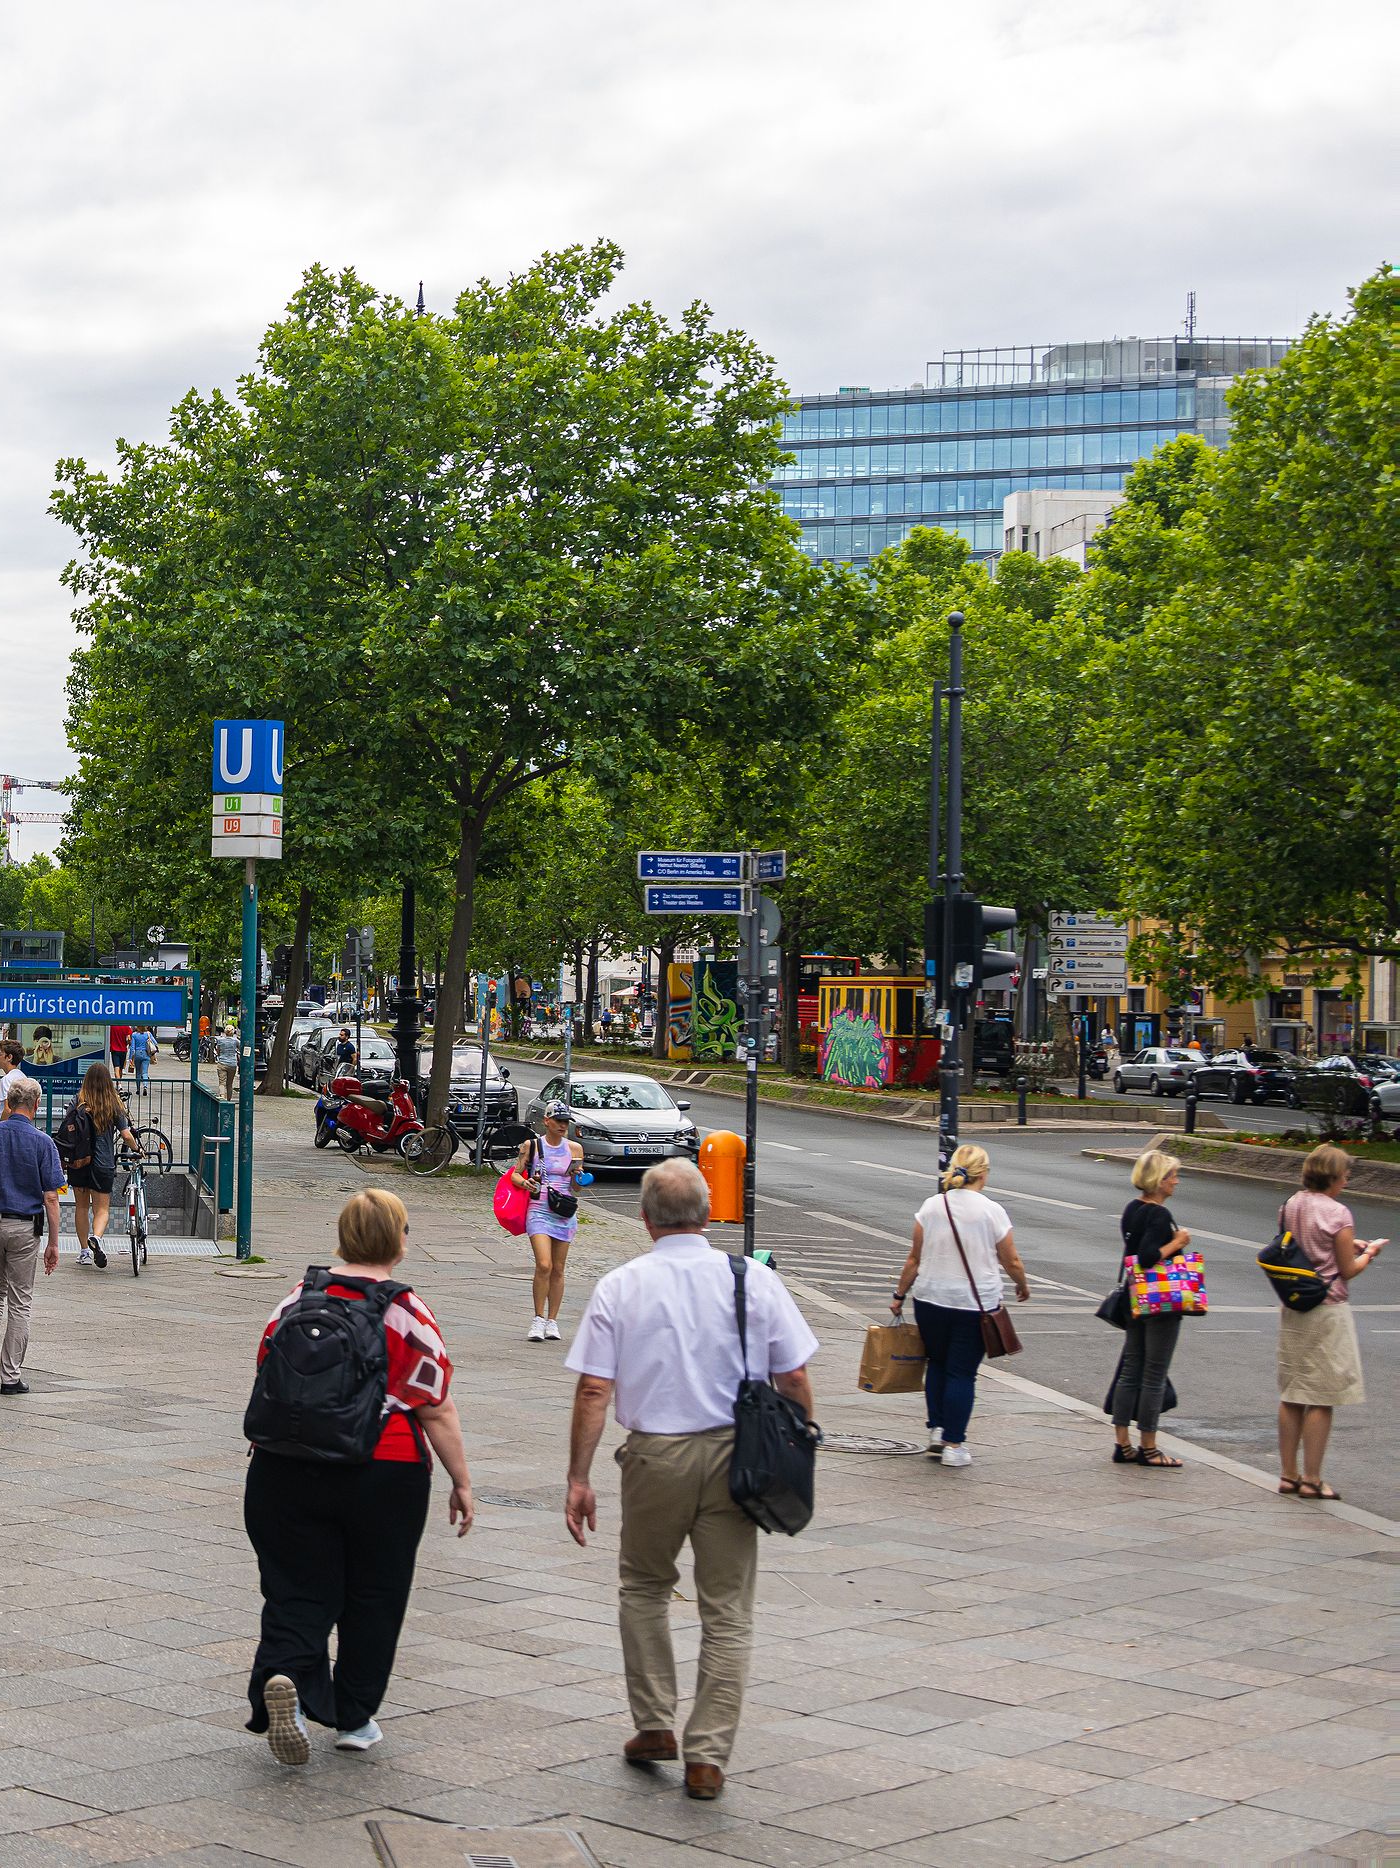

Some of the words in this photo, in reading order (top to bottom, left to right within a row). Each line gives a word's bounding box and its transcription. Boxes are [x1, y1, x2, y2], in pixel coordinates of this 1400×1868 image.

[220, 728, 252, 784] U
[226, 799, 239, 810] U1
[225, 821, 239, 832] U9
